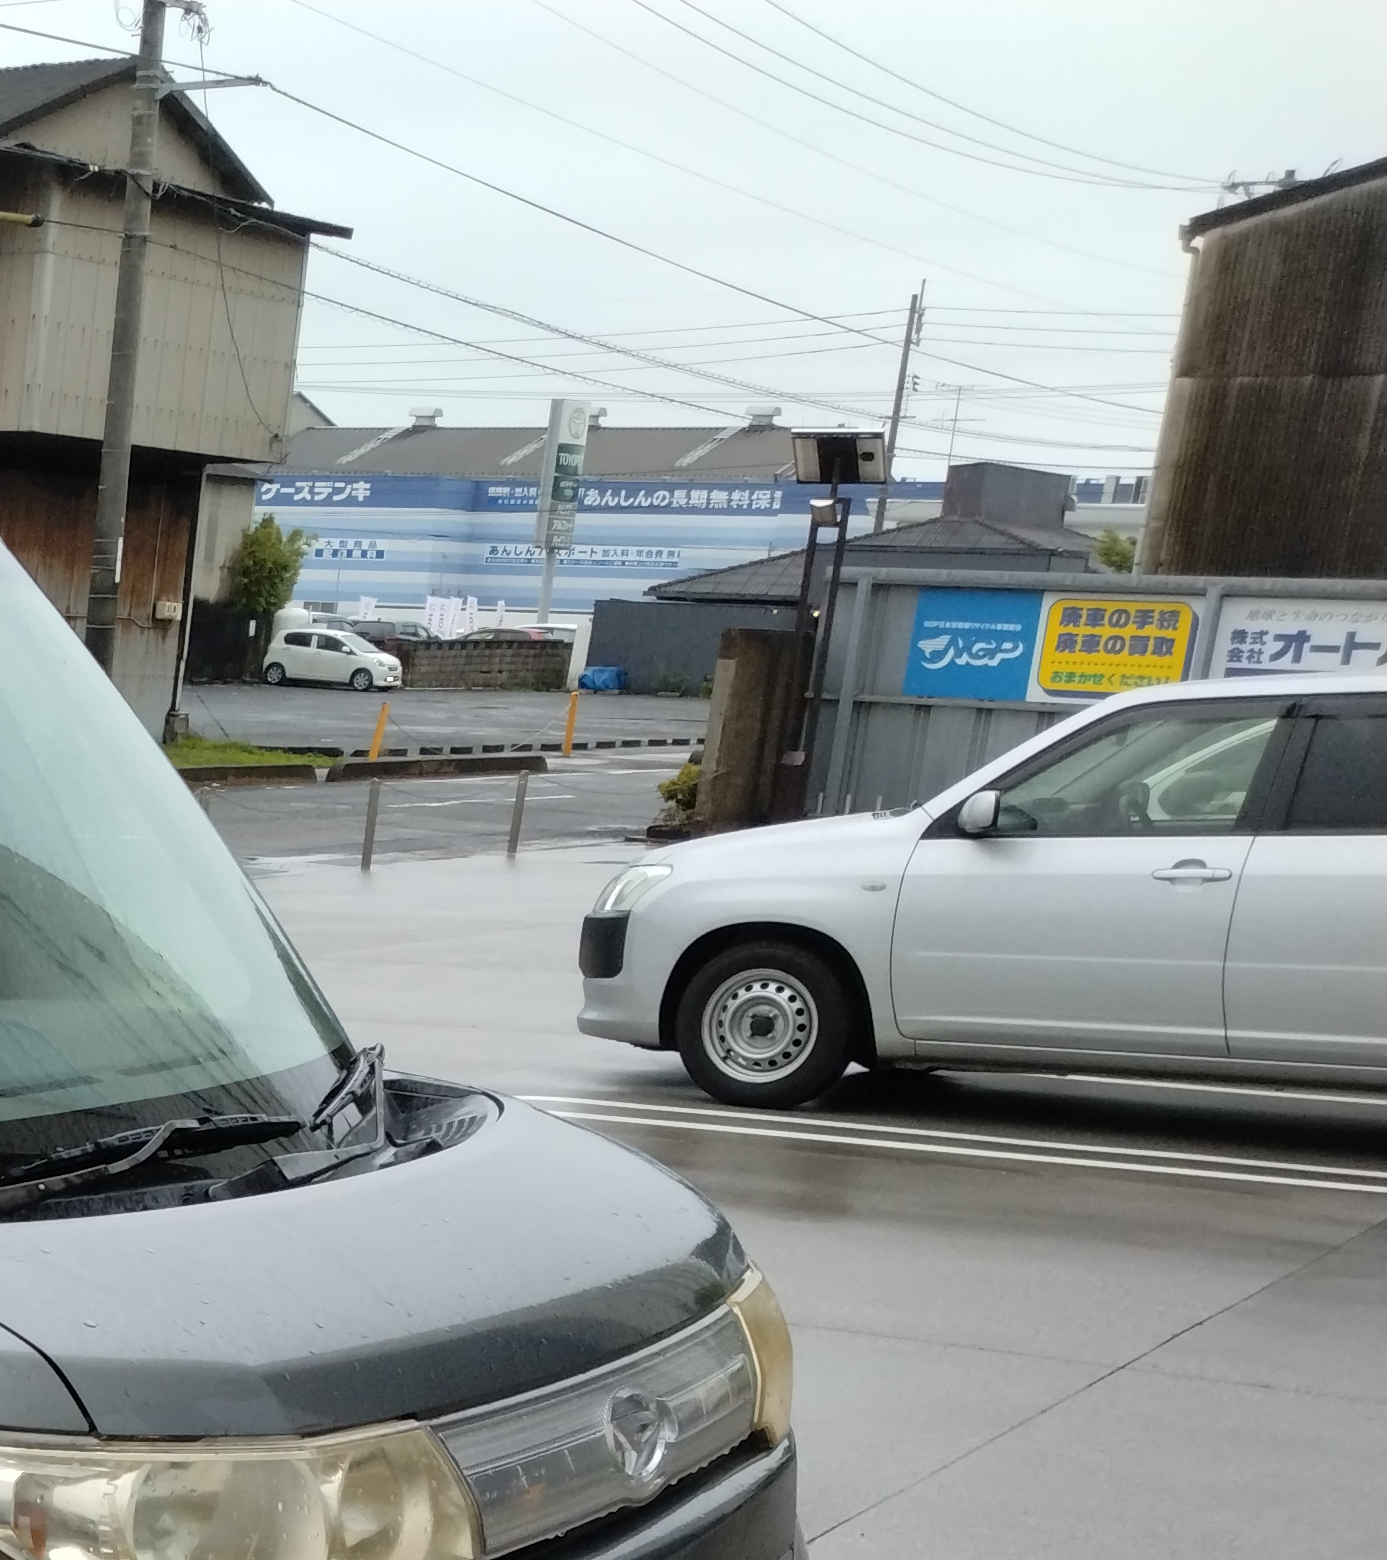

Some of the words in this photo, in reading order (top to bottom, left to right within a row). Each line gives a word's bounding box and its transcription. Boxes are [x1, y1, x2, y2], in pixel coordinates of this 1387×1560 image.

[261, 481, 372, 501] ケーズデンキ
[1059, 606, 1182, 631] 廃車の手続
[1055, 632, 1176, 658] 廃車の買取
[1230, 628, 1269, 646] 株式
[1269, 629, 1387, 667] オート
[1227, 647, 1265, 665] 会社
